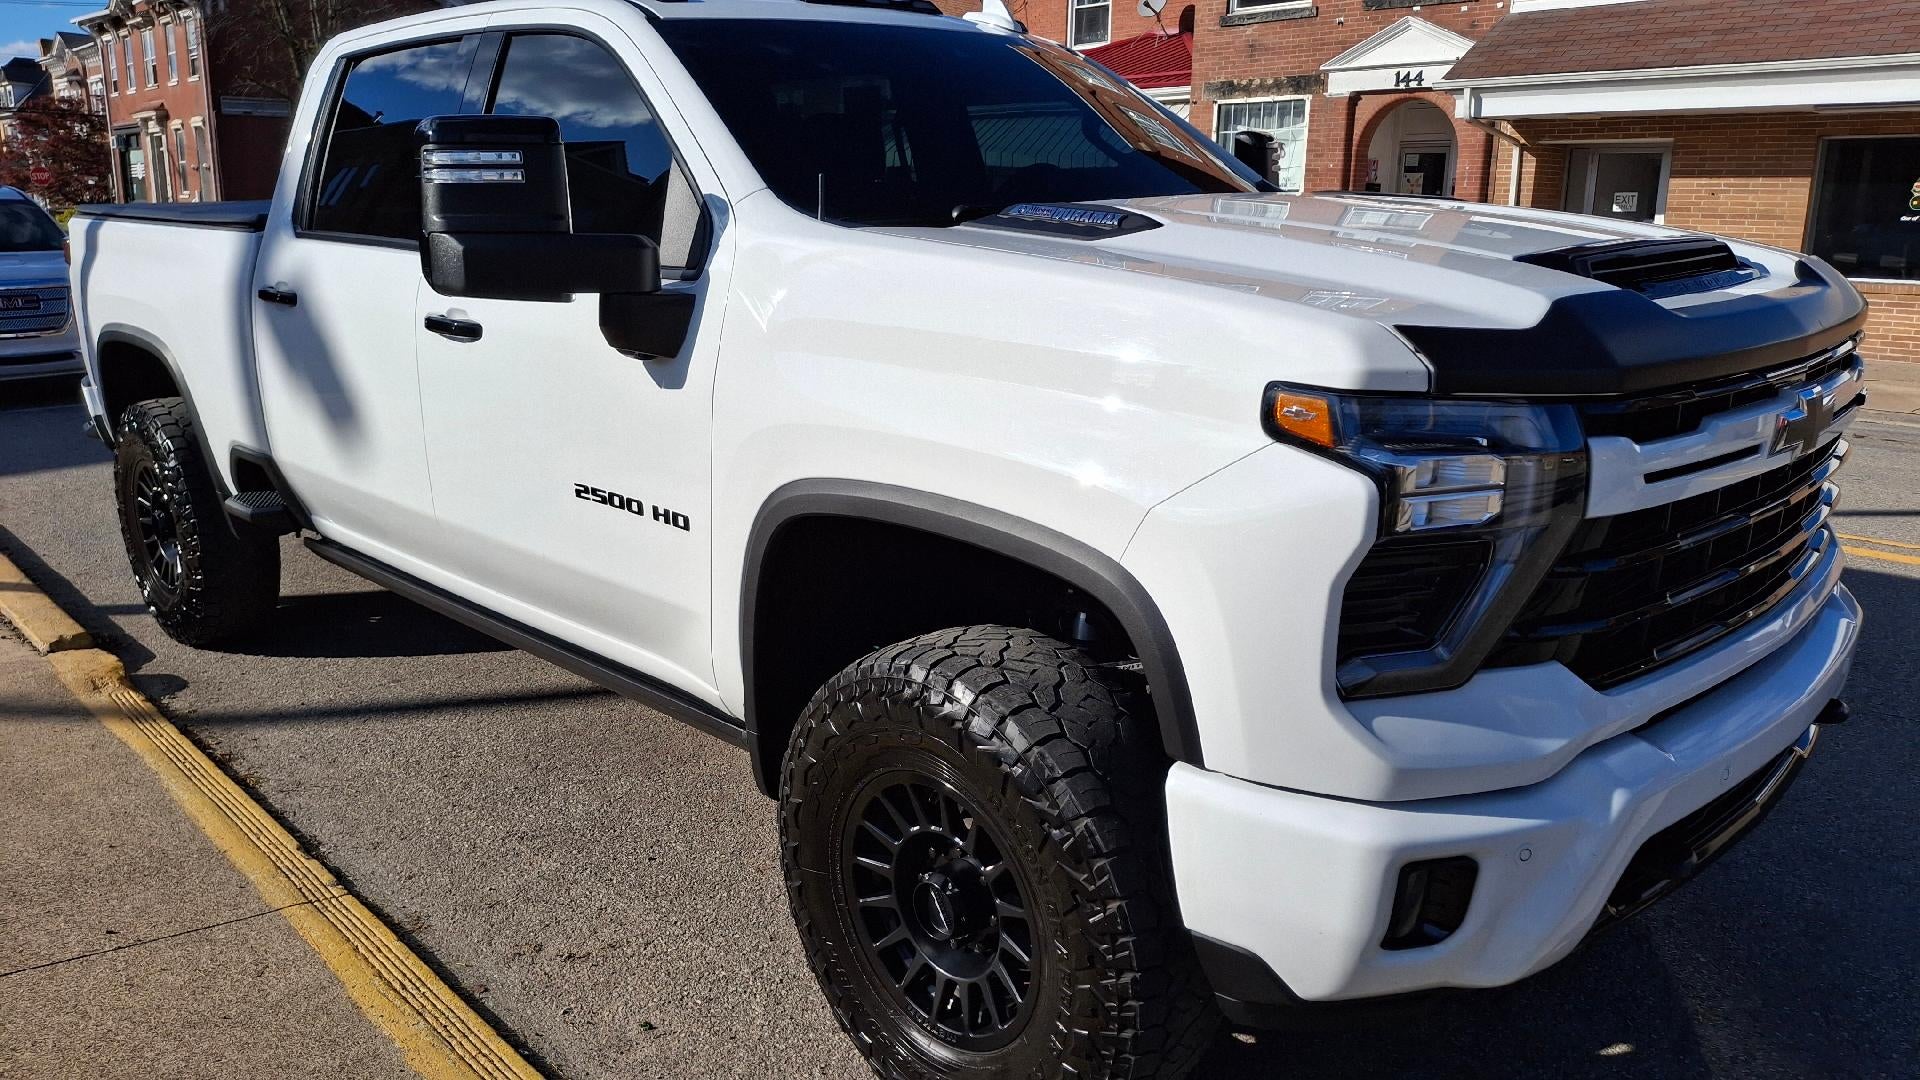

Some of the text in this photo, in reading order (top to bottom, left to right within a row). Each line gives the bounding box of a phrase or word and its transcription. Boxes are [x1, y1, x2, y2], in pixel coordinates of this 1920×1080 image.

[1394, 69, 1425, 88] 144
[32, 172, 50, 180] STOP
[1615, 194, 1636, 204] EXIT
[574, 483, 691, 532] 2500 HD
